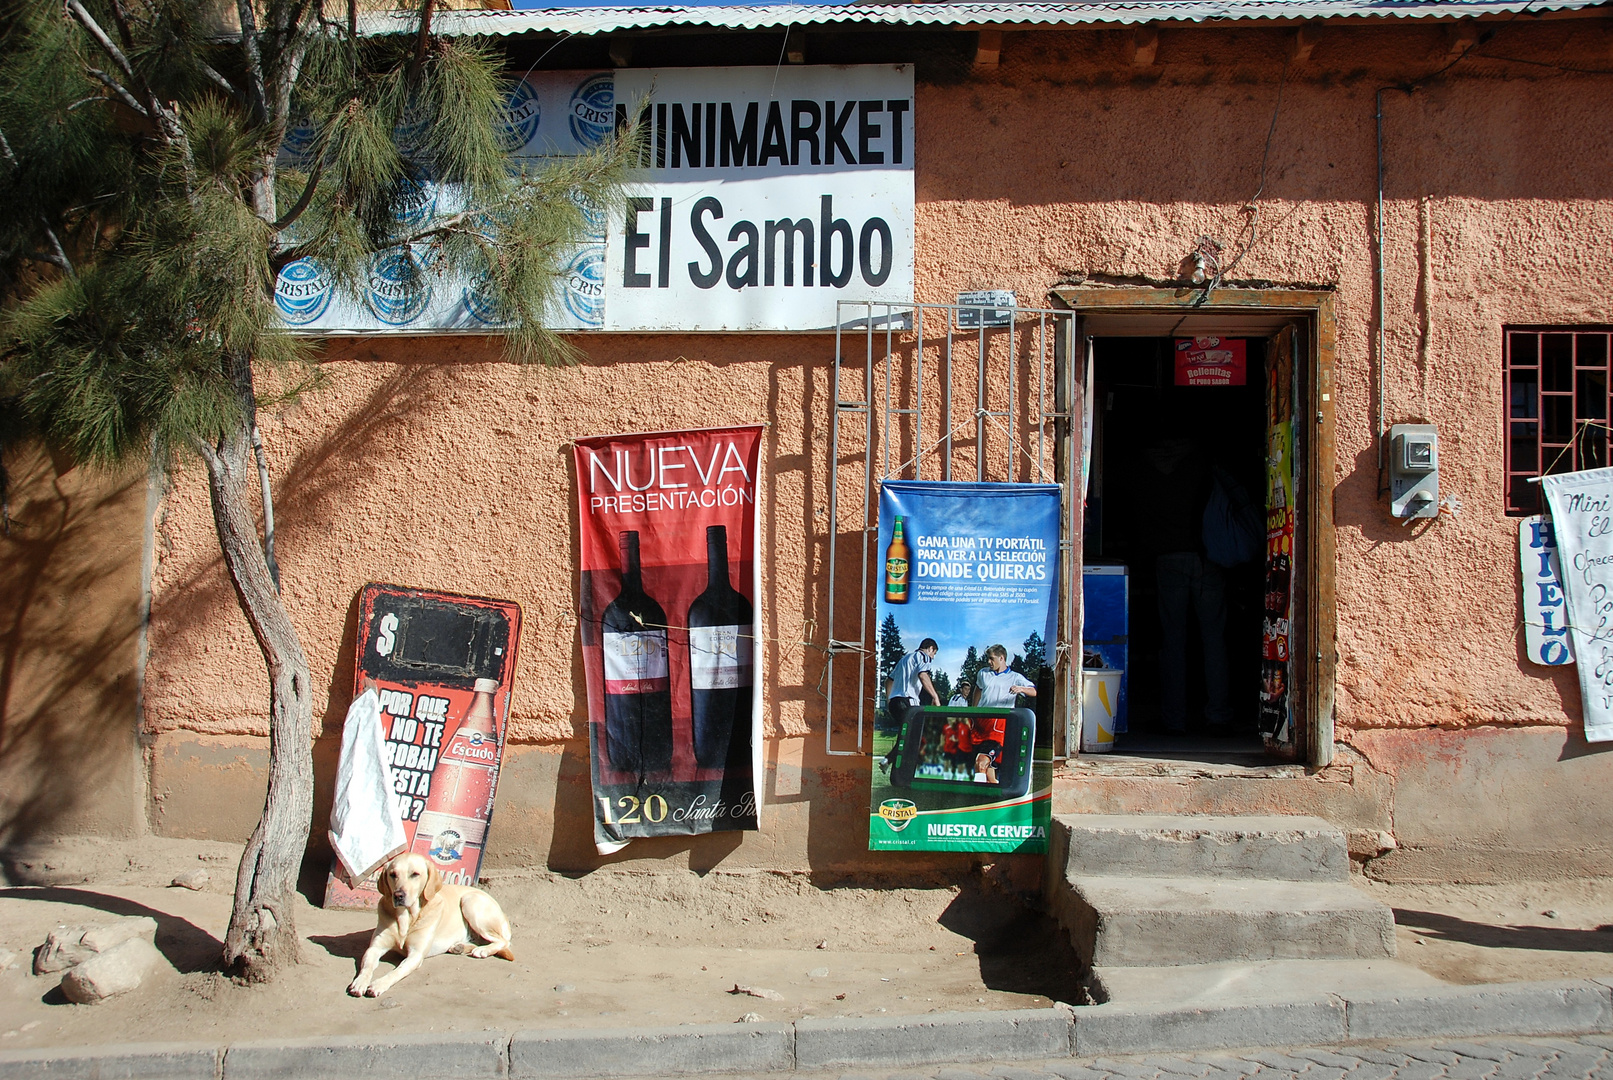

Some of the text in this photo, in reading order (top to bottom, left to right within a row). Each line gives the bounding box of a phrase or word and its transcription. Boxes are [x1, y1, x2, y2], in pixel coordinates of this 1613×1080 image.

[615, 100, 909, 168] MINIMARKET
[623, 194, 893, 289] El Sambo
[1187, 367, 1231, 378] Rellenitas
[590, 442, 751, 493] NUEVA
[591, 484, 753, 514] PRESENTACIÓN
[1563, 493, 1611, 514] Mini
[917, 536, 1046, 550] GANA UNA TV PORTÁTIL
[918, 549, 1046, 562] PARA VER A LA SELECCIÓN
[918, 562, 1046, 582] DONDE QUIERAS
[1529, 522, 1568, 665] HIELO
[376, 613, 399, 657] $
[620, 638, 655, 656] 120
[380, 689, 449, 722] POR QUE
[390, 717, 444, 747] NO TE
[452, 742, 494, 760] Escudo
[599, 795, 668, 825] 120
[672, 795, 726, 822] Santa
[882, 808, 914, 818] CRISTAL
[928, 824, 1046, 838] NUESTRA CERVEZA
